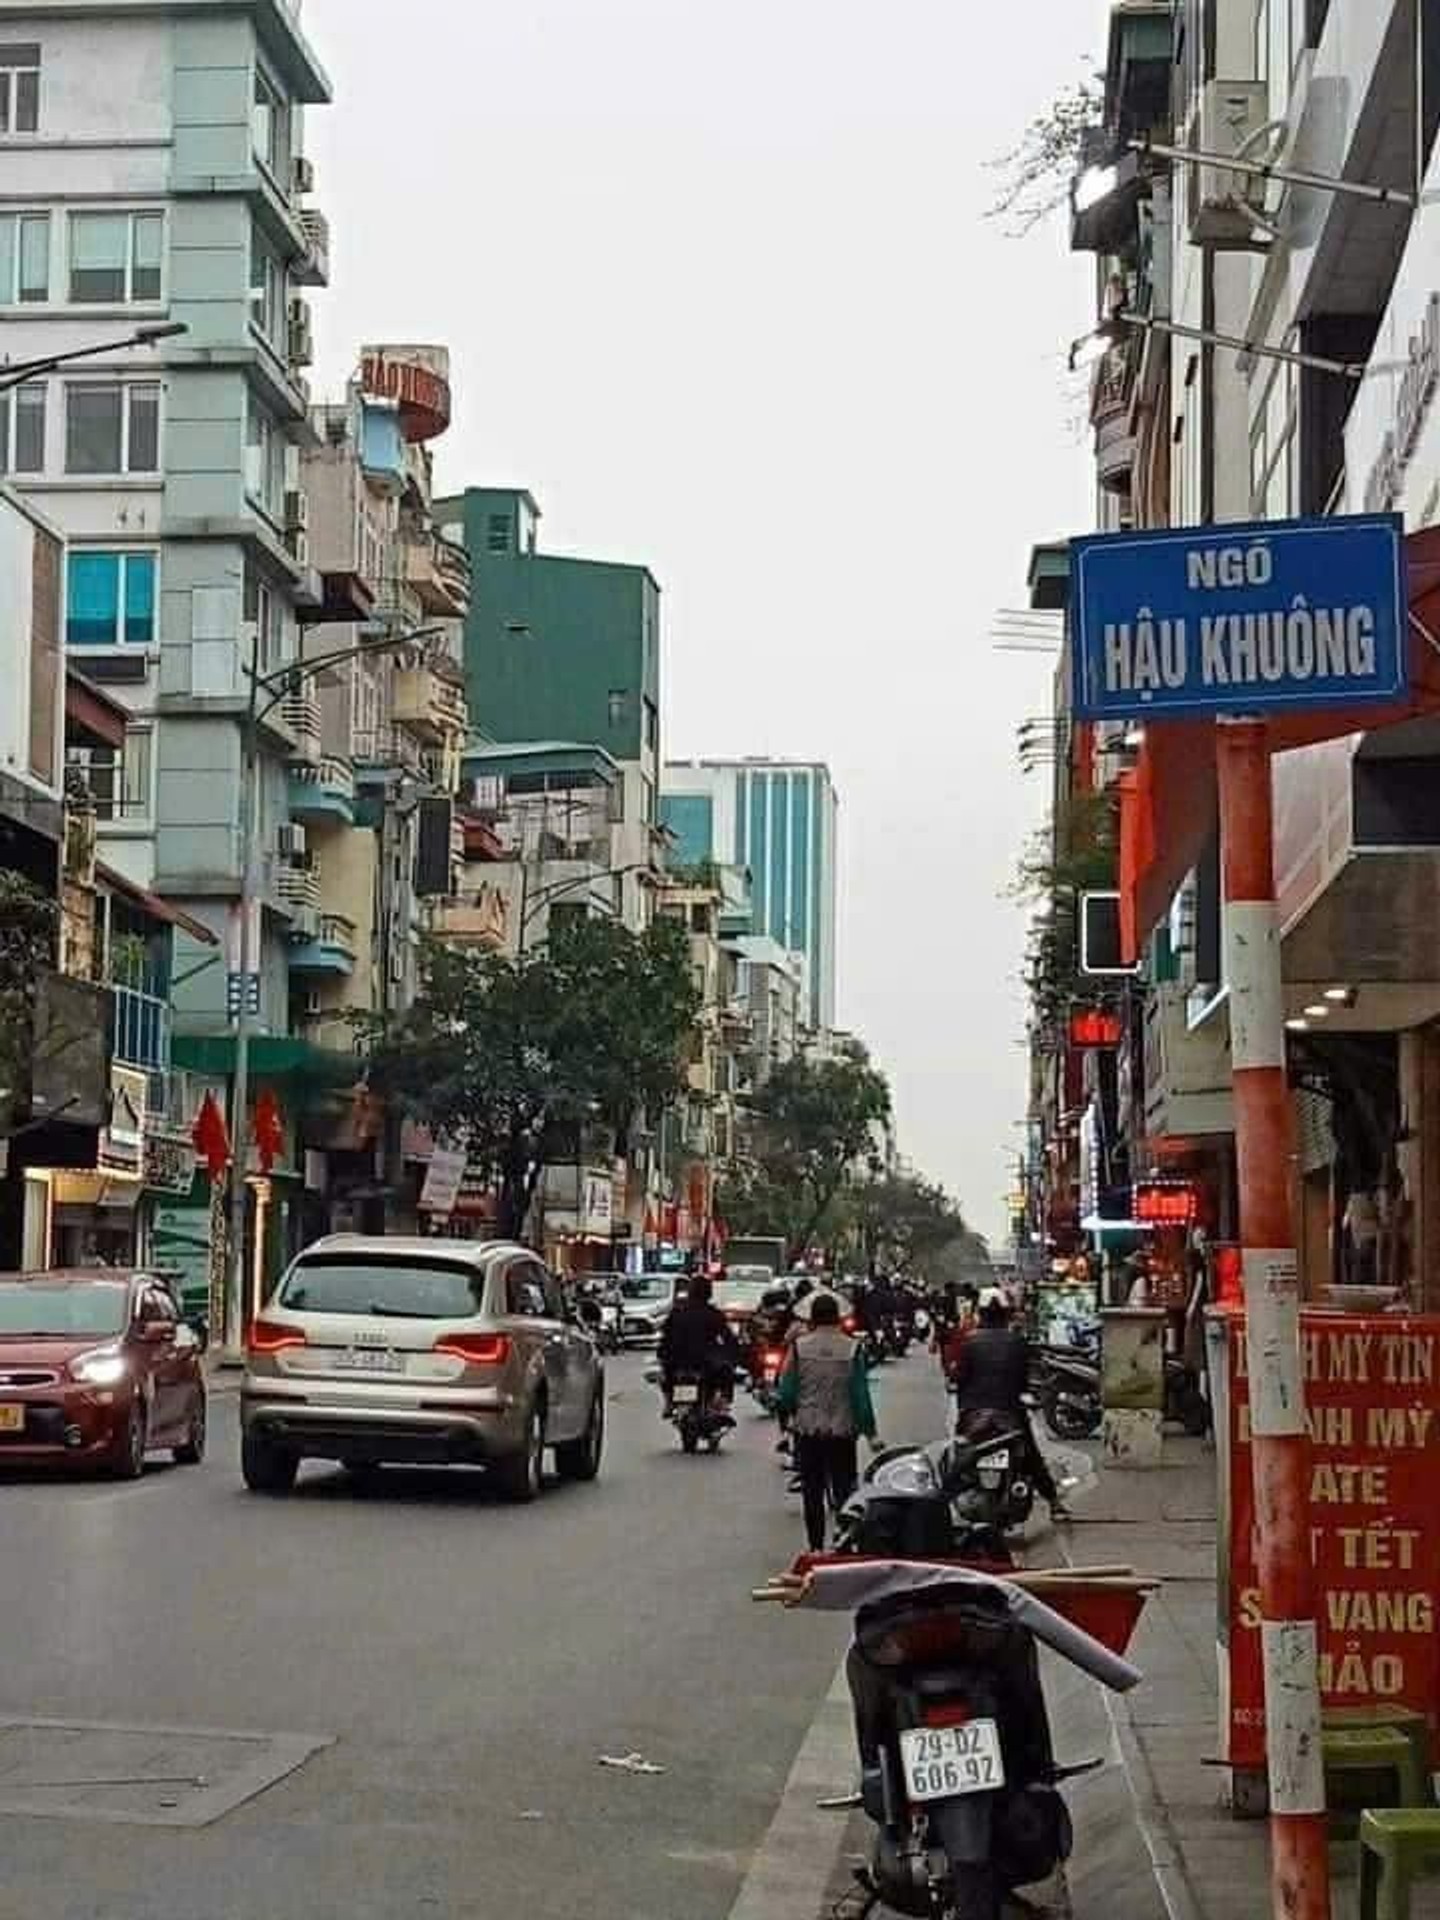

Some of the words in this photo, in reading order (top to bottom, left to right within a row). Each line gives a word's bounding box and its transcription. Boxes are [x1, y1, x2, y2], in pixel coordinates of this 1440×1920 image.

[1187, 539, 1272, 588] NGÕ
[1104, 607, 1187, 701] HẬU
[1201, 595, 1376, 685] KHUÔNG
[1310, 1463, 1389, 1505] ATE
[1335, 1515, 1421, 1570] TẾT
[1327, 1591, 1433, 1633] VANG
